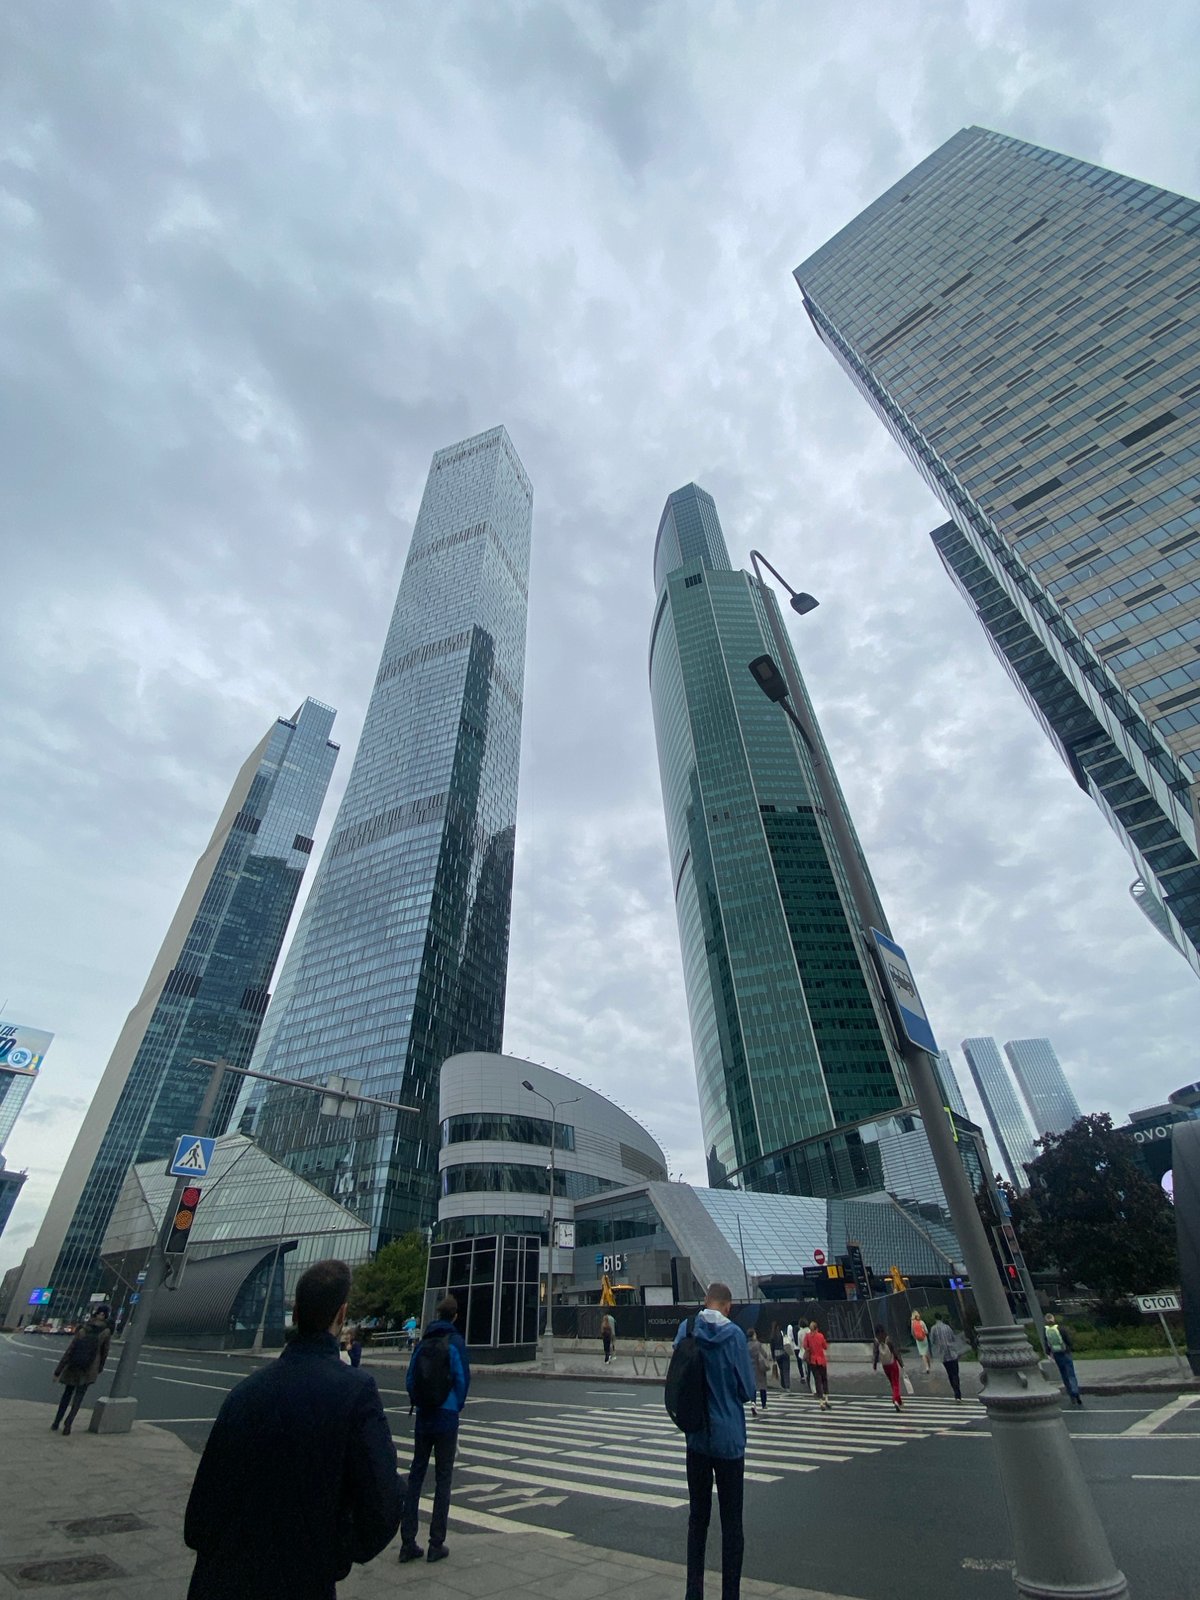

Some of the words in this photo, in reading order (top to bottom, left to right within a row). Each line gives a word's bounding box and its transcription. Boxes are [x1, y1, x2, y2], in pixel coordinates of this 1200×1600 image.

[1131, 1124, 1173, 1143] OVO
[603, 1254, 622, 1272] ВТБ
[1142, 1297, 1175, 1309] СТОП
